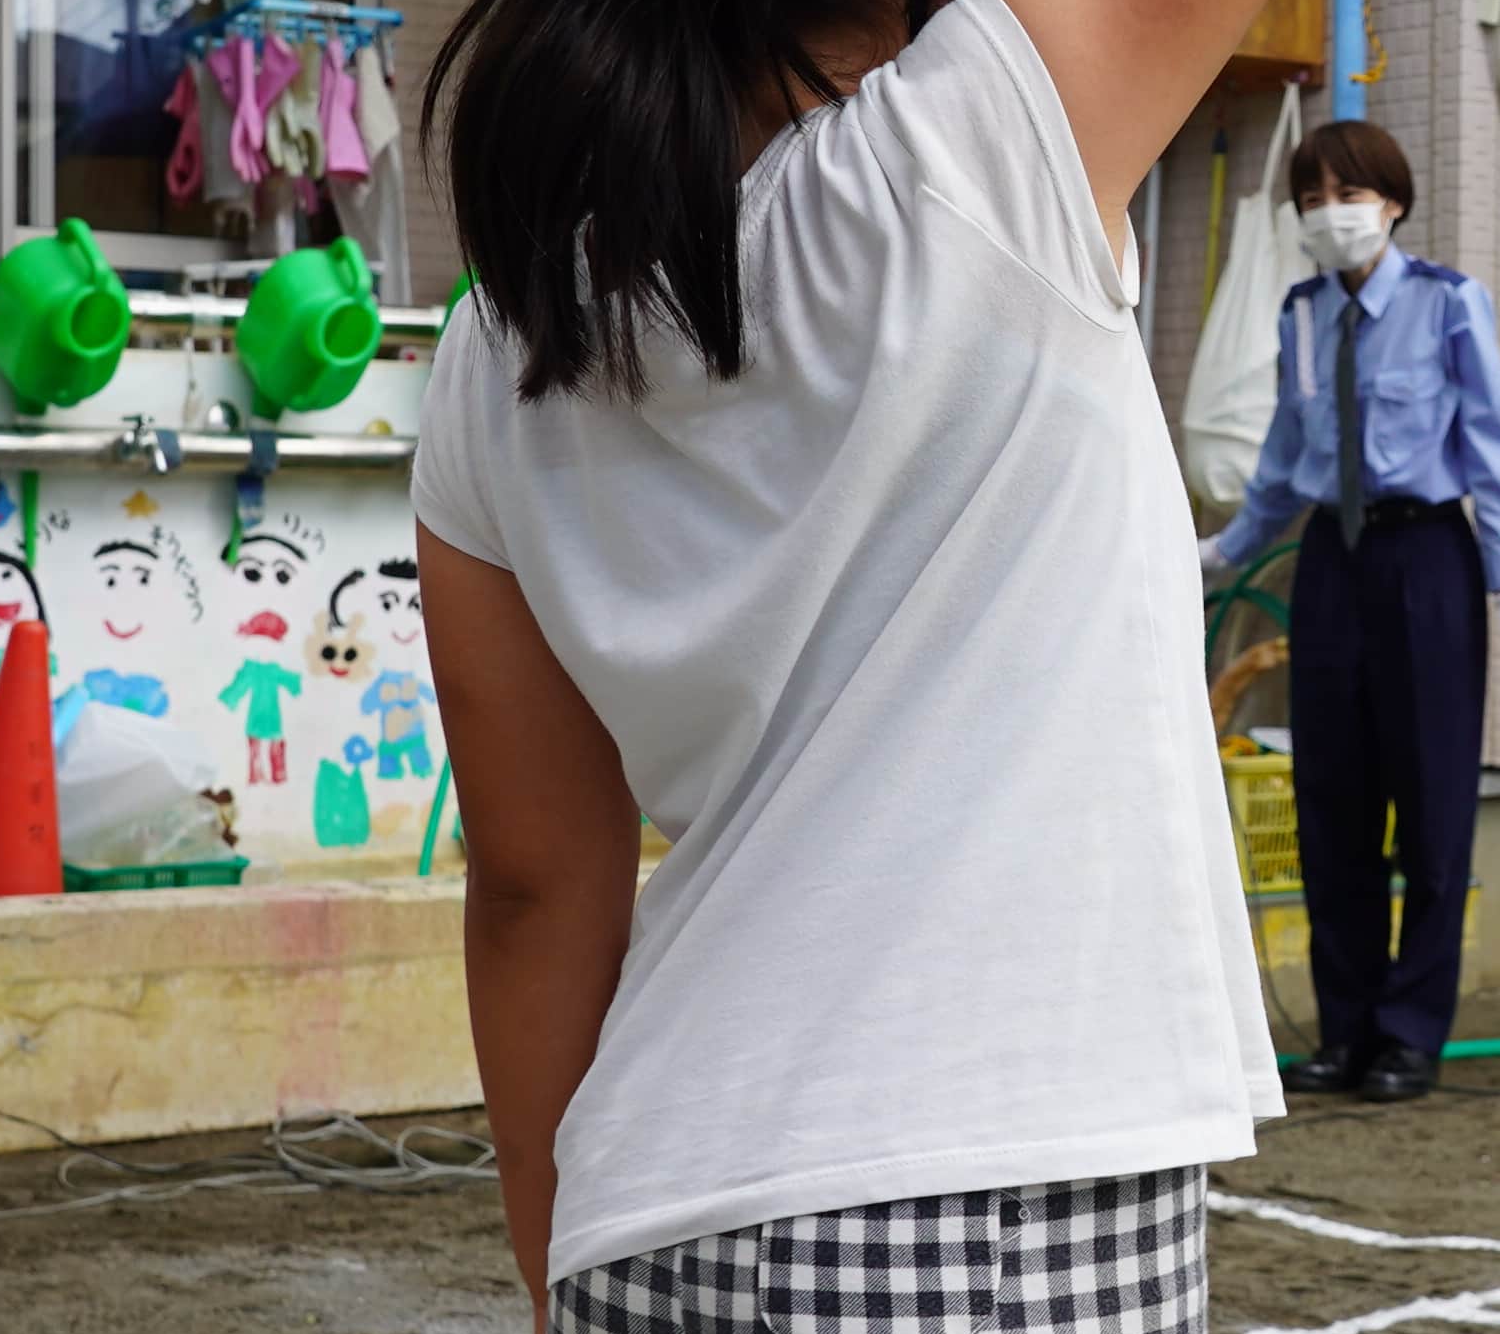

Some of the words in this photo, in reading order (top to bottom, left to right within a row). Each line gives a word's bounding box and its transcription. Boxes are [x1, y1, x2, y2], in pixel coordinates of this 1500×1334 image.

[282, 513, 327, 554] りょう
[151, 524, 204, 624] そうたろう
